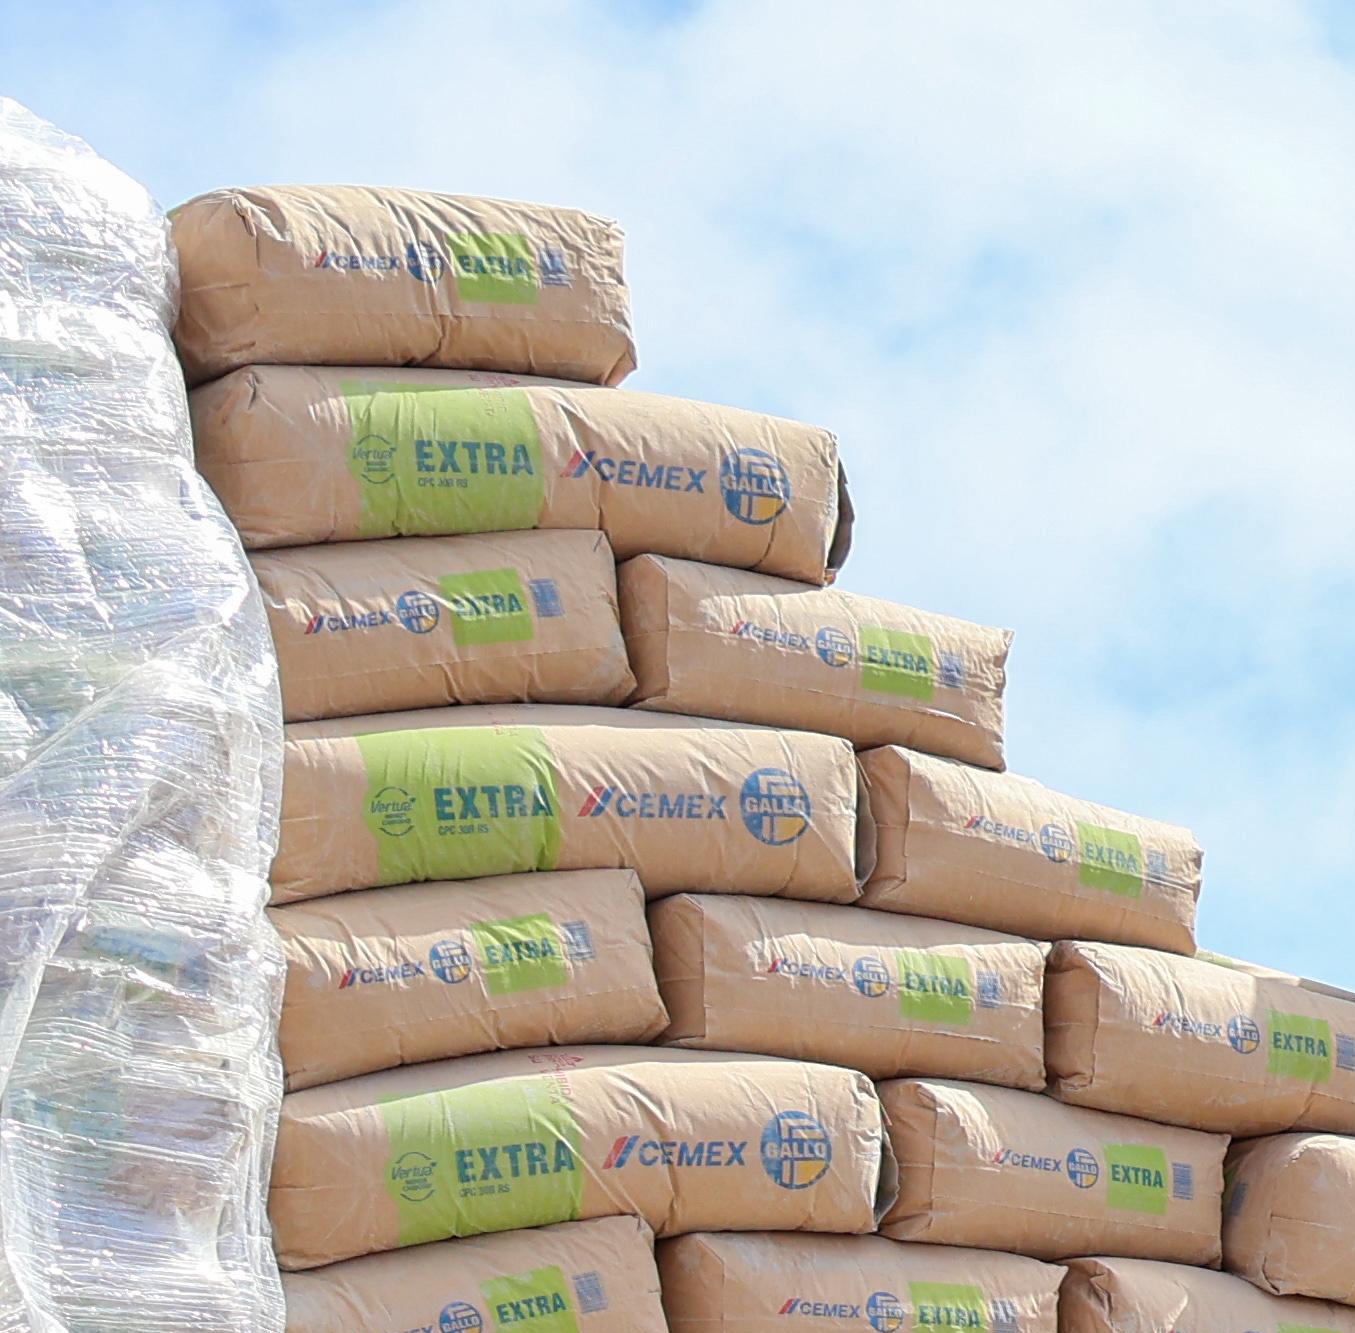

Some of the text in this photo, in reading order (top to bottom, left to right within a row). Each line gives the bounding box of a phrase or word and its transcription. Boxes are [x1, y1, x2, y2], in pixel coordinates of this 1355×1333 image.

[337, 255, 401, 271] CEMEX
[414, 439, 537, 477] EXTRA
[595, 456, 708, 495] CEMEX
[326, 610, 392, 632] CEMEX
[750, 626, 930, 674] CEMEX EXTRA
[369, 798, 416, 816] Vertua
[433, 784, 555, 822] EXTRA
[615, 791, 727, 822] CEMEX
[983, 819, 1138, 873] CEMEX EXTRA
[361, 960, 425, 985] CEMEX
[904, 970, 969, 998] EXTRA
[1272, 1031, 1328, 1058] EXTRA
[391, 1138, 830, 1185] Vertua EXTRA CEMEX GALLO
[1011, 1152, 1165, 1189] CEMEX EXTRA
[496, 1291, 569, 1325] EXTRA
[800, 1301, 981, 1329] CEMEX EXTRA
